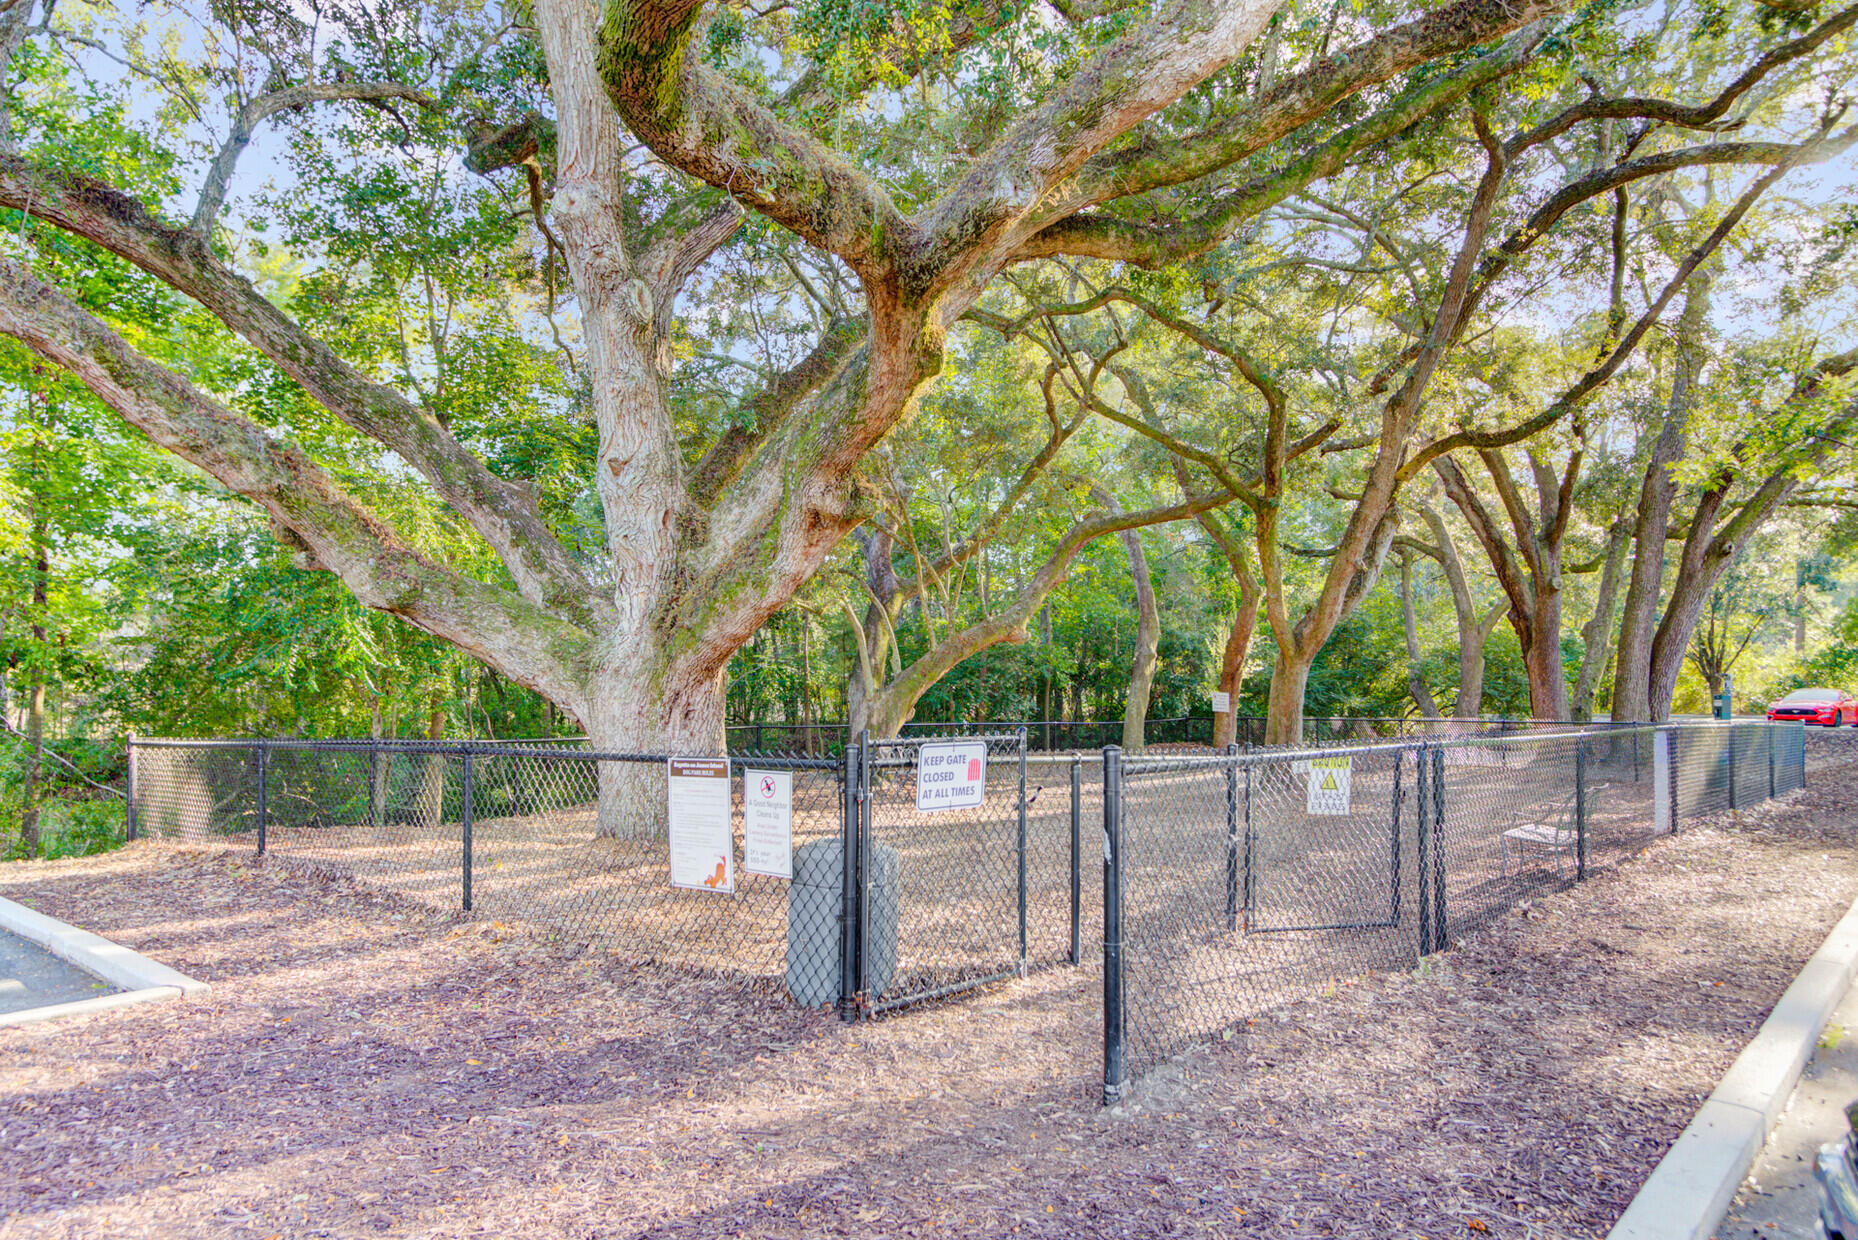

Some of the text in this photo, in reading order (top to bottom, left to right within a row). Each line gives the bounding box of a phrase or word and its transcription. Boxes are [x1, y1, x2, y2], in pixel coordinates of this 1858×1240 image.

[924, 755, 966, 766] KEEP GATE
[923, 772, 954, 783] CLOSED
[922, 786, 975, 800] AT ALL TIMES
